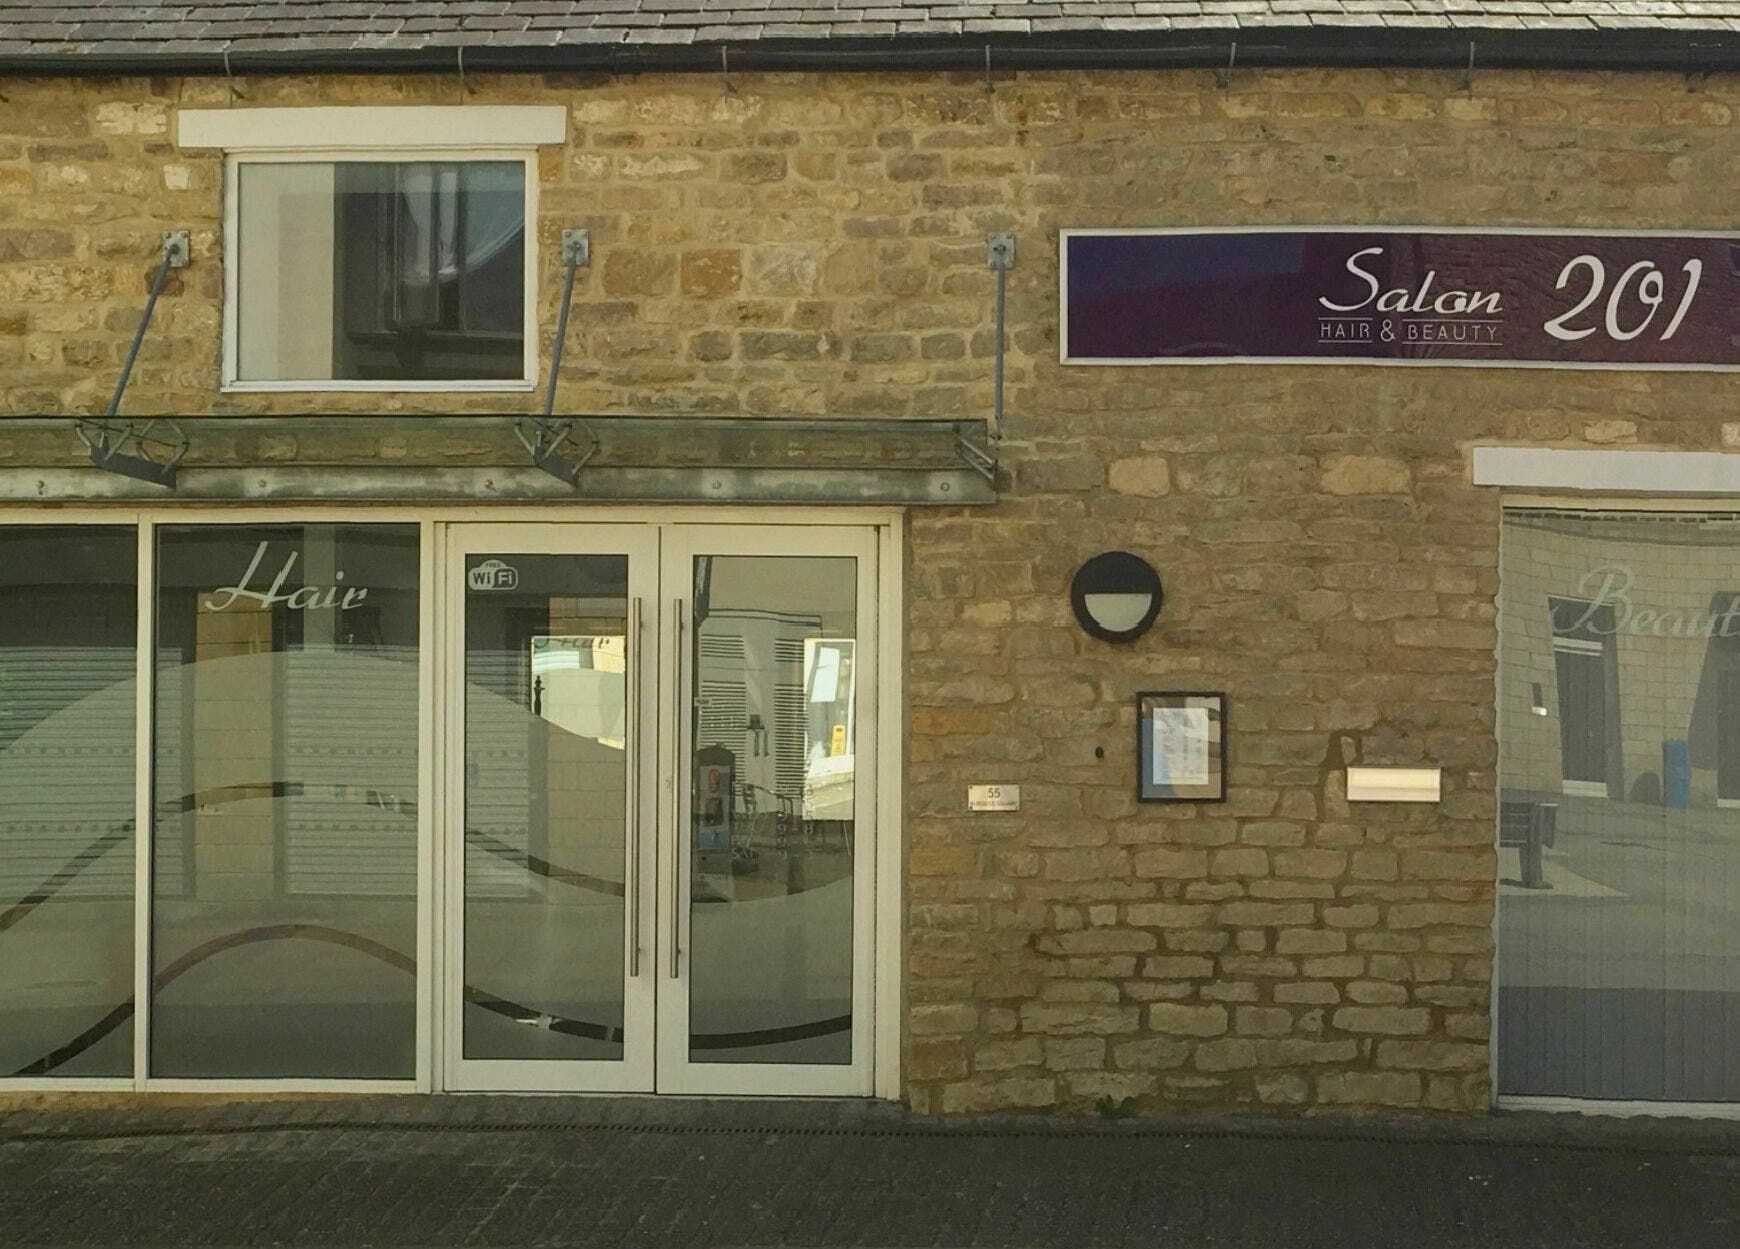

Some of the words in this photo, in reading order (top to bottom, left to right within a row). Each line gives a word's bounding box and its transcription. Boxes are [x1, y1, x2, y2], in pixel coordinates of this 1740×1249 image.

[1318, 246, 1503, 314] Salon
[1543, 253, 1703, 342] 201
[1320, 322, 1370, 339] HAIR
[1380, 318, 1396, 343] &
[1406, 323, 1498, 341] BEAUTY
[204, 540, 368, 609] Hair
